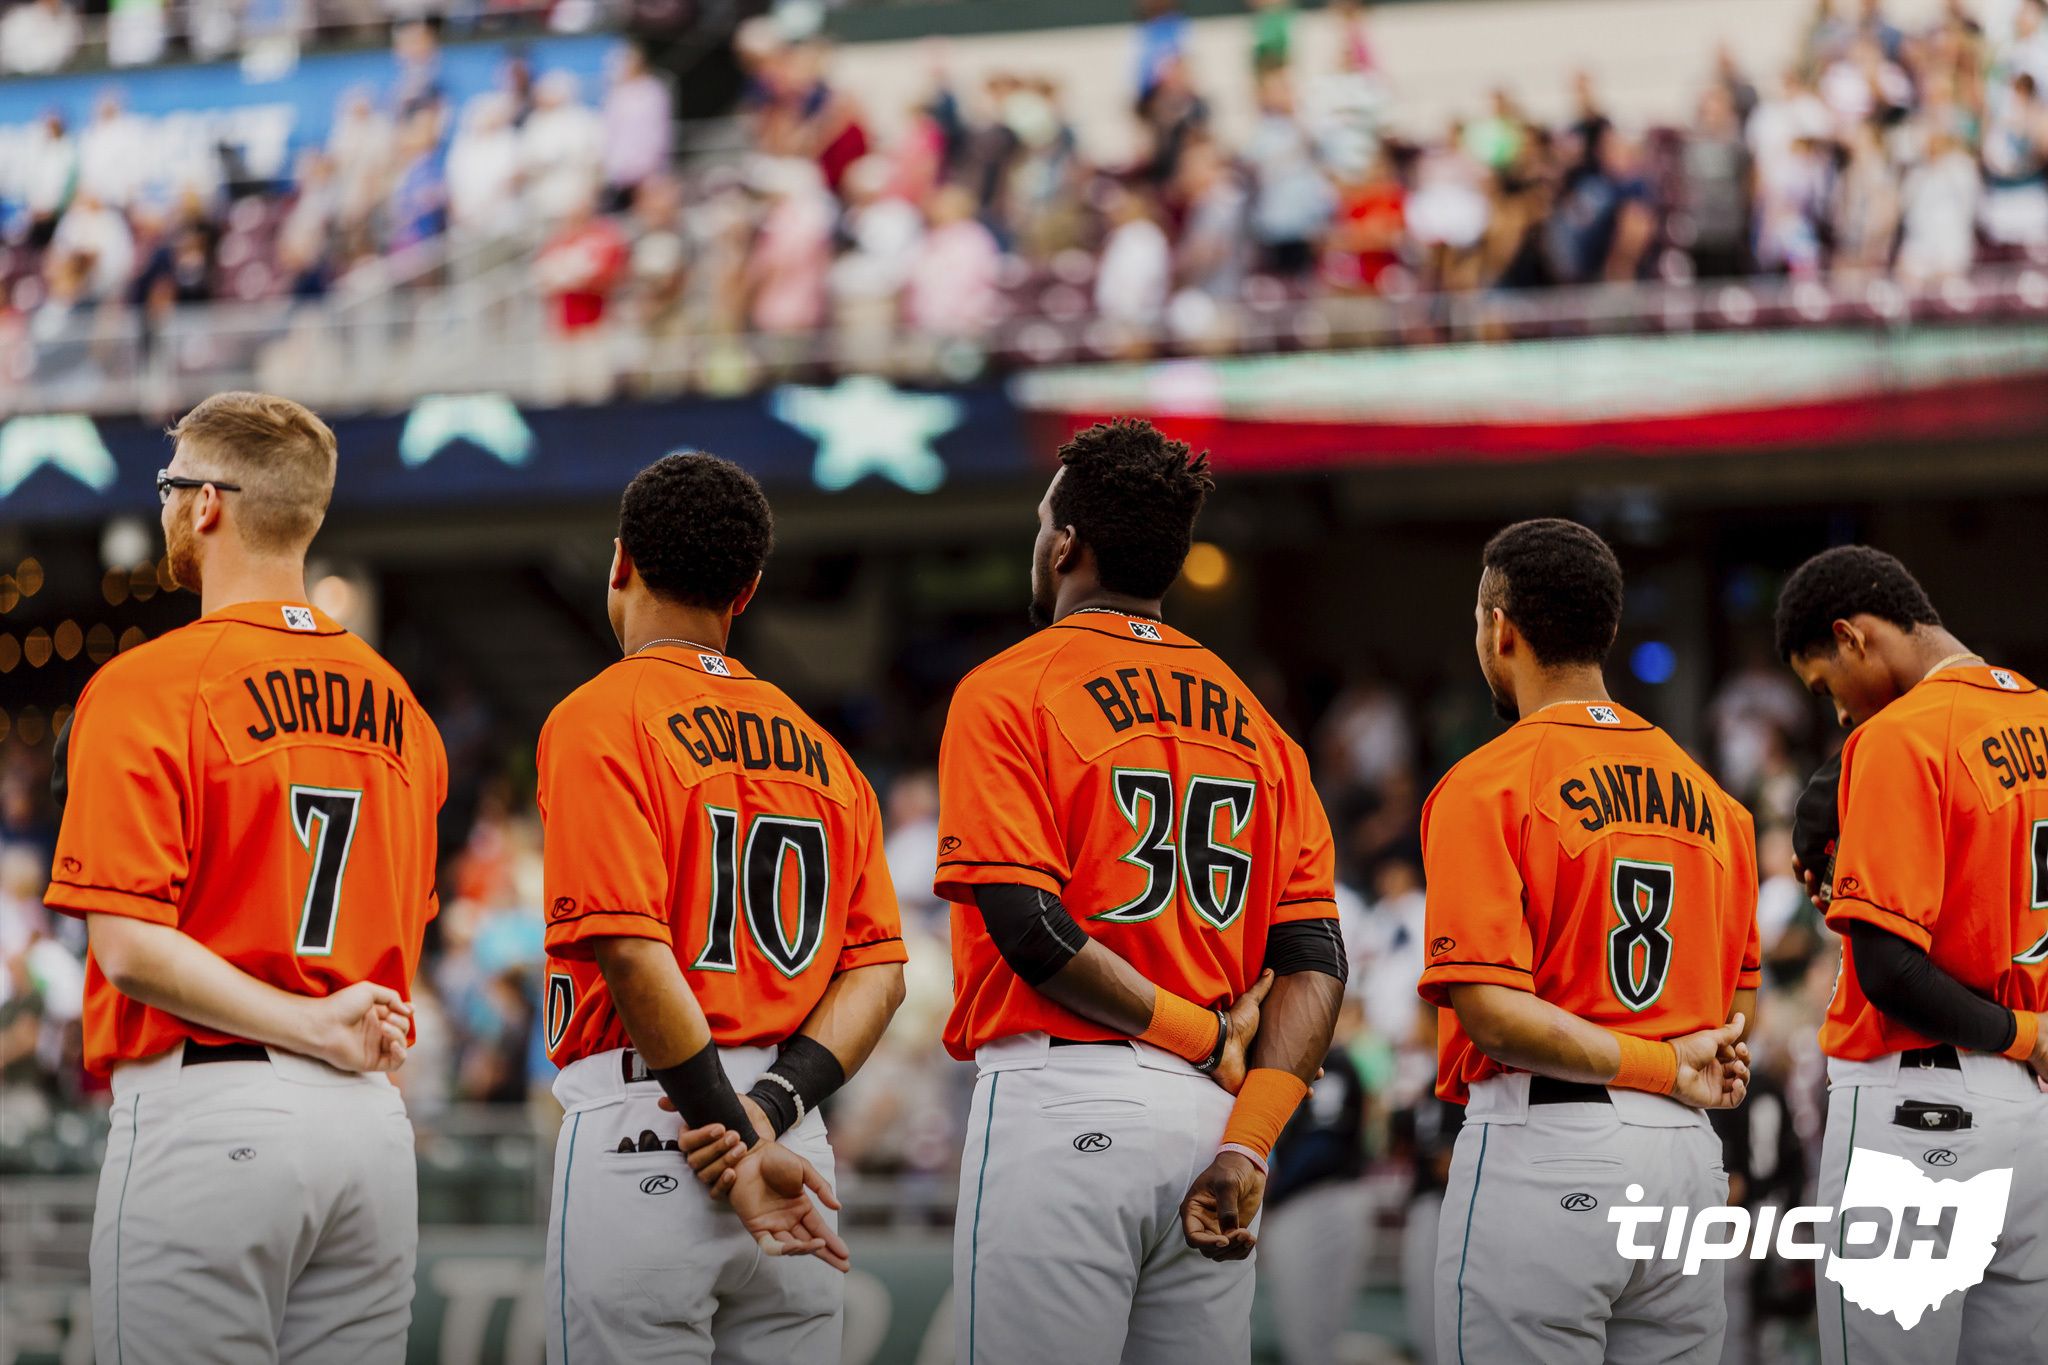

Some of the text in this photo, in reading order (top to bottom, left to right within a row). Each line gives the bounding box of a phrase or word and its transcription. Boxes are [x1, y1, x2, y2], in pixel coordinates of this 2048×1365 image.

[244, 668, 404, 757] JORDAN
[667, 705, 829, 787] GORDON
[1083, 668, 1257, 751] BELTRE
[1982, 727, 2048, 789] SUG
[1560, 764, 1716, 844] SANTANA
[289, 784, 362, 956] 7
[690, 804, 830, 979] 10
[1089, 767, 1257, 932] 36
[1608, 857, 1674, 1013] 8
